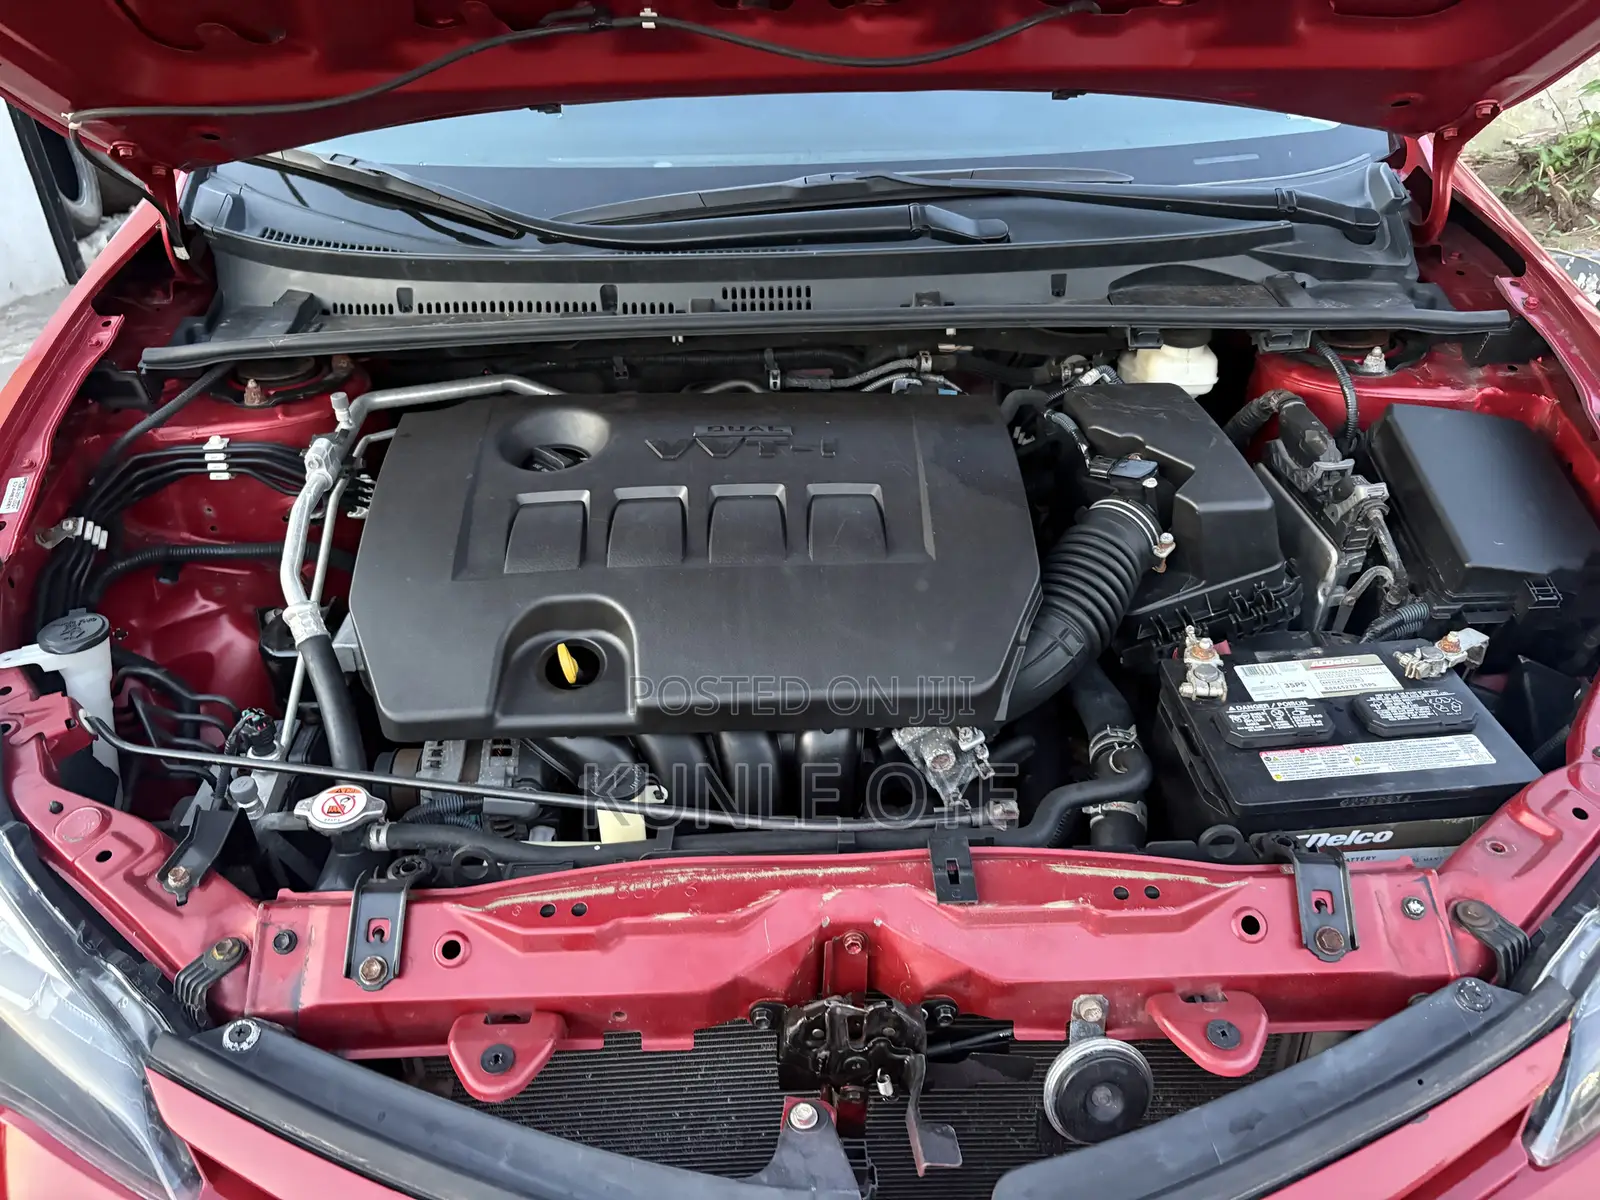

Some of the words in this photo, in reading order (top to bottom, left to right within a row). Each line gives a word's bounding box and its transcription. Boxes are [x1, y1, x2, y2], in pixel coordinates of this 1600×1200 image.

[702, 424, 786, 434] DUAL
[1235, 703, 1270, 711] DANGER
[1296, 829, 1394, 848] Delco
[1346, 855, 1377, 863] ATTERY
